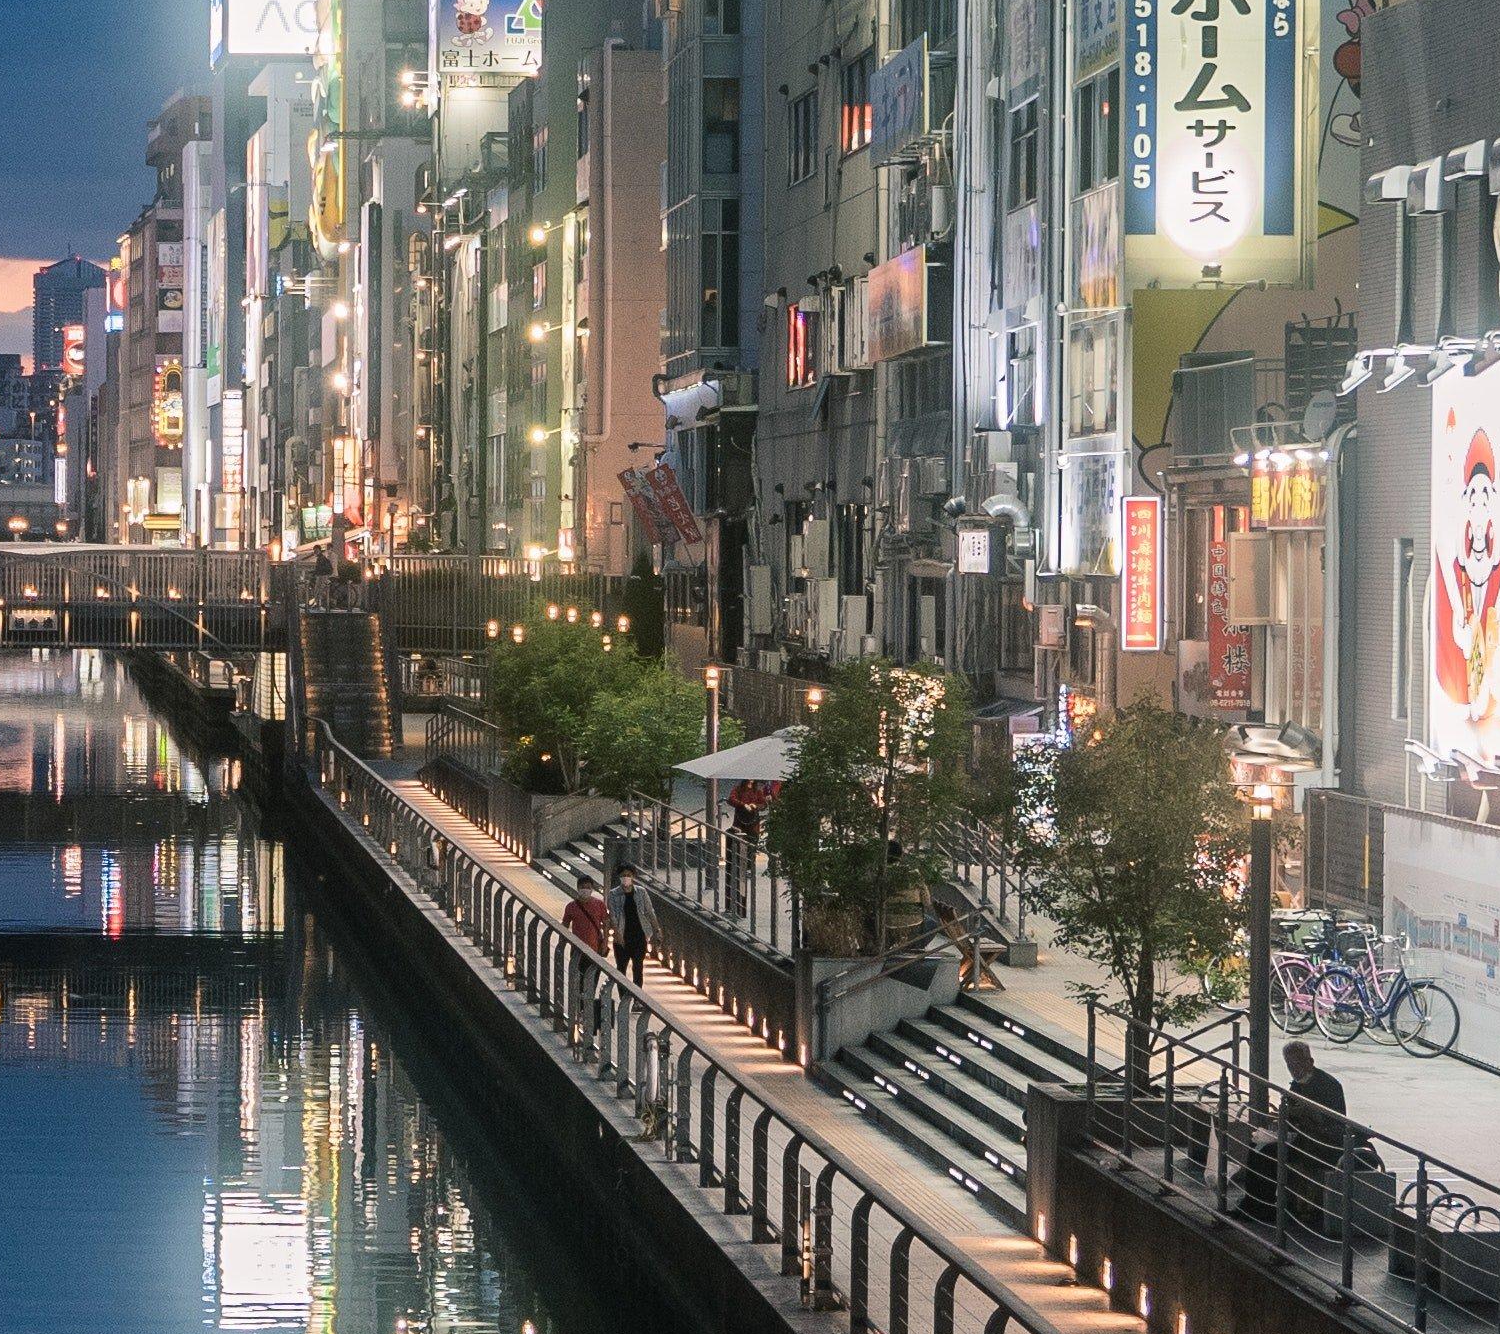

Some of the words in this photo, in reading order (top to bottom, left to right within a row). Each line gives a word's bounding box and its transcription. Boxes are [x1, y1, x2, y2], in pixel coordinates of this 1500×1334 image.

[441, 49, 540, 68] 富士ホーム
